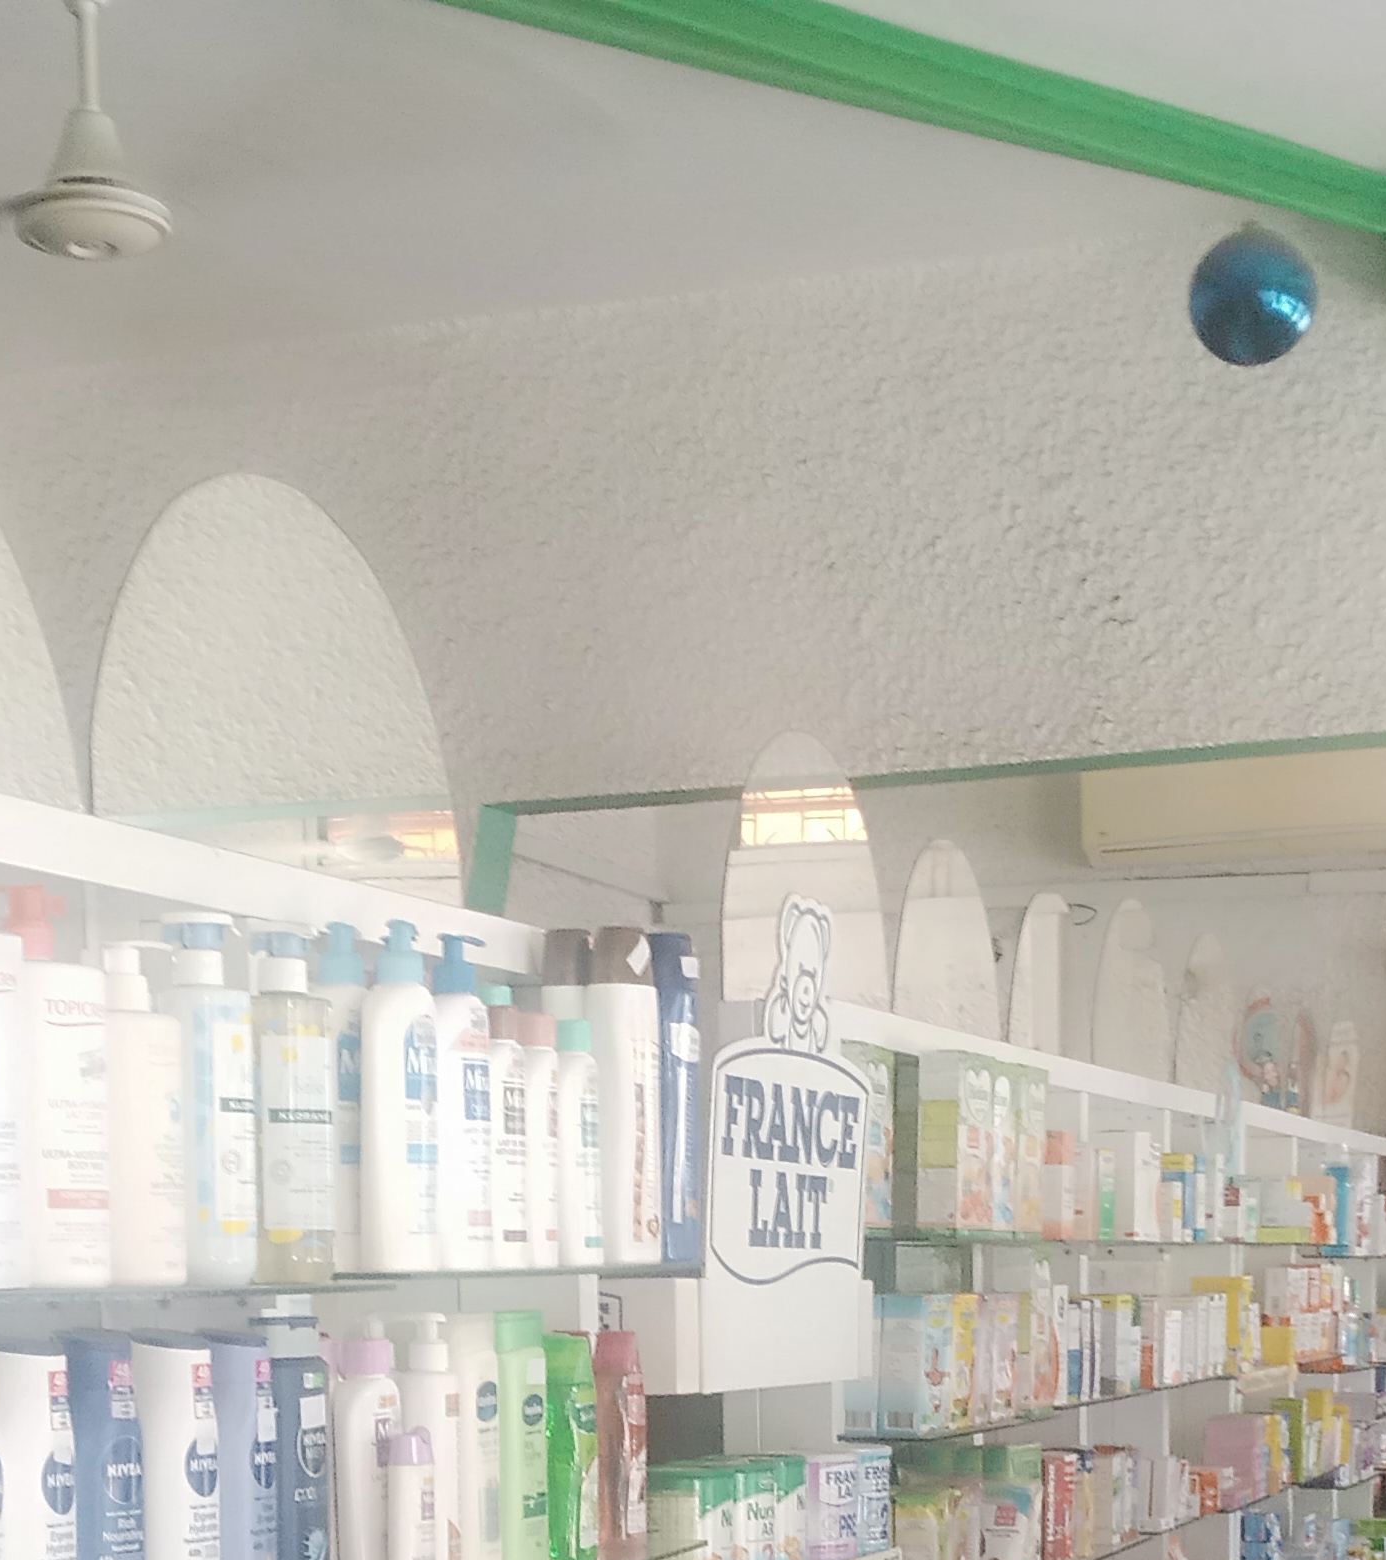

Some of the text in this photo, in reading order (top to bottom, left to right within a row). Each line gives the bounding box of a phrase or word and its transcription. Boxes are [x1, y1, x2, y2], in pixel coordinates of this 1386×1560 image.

[722, 1075, 861, 1169] FRANCE
[747, 1170, 829, 1250] LAIT
[107, 1462, 143, 1479] NIVEA
